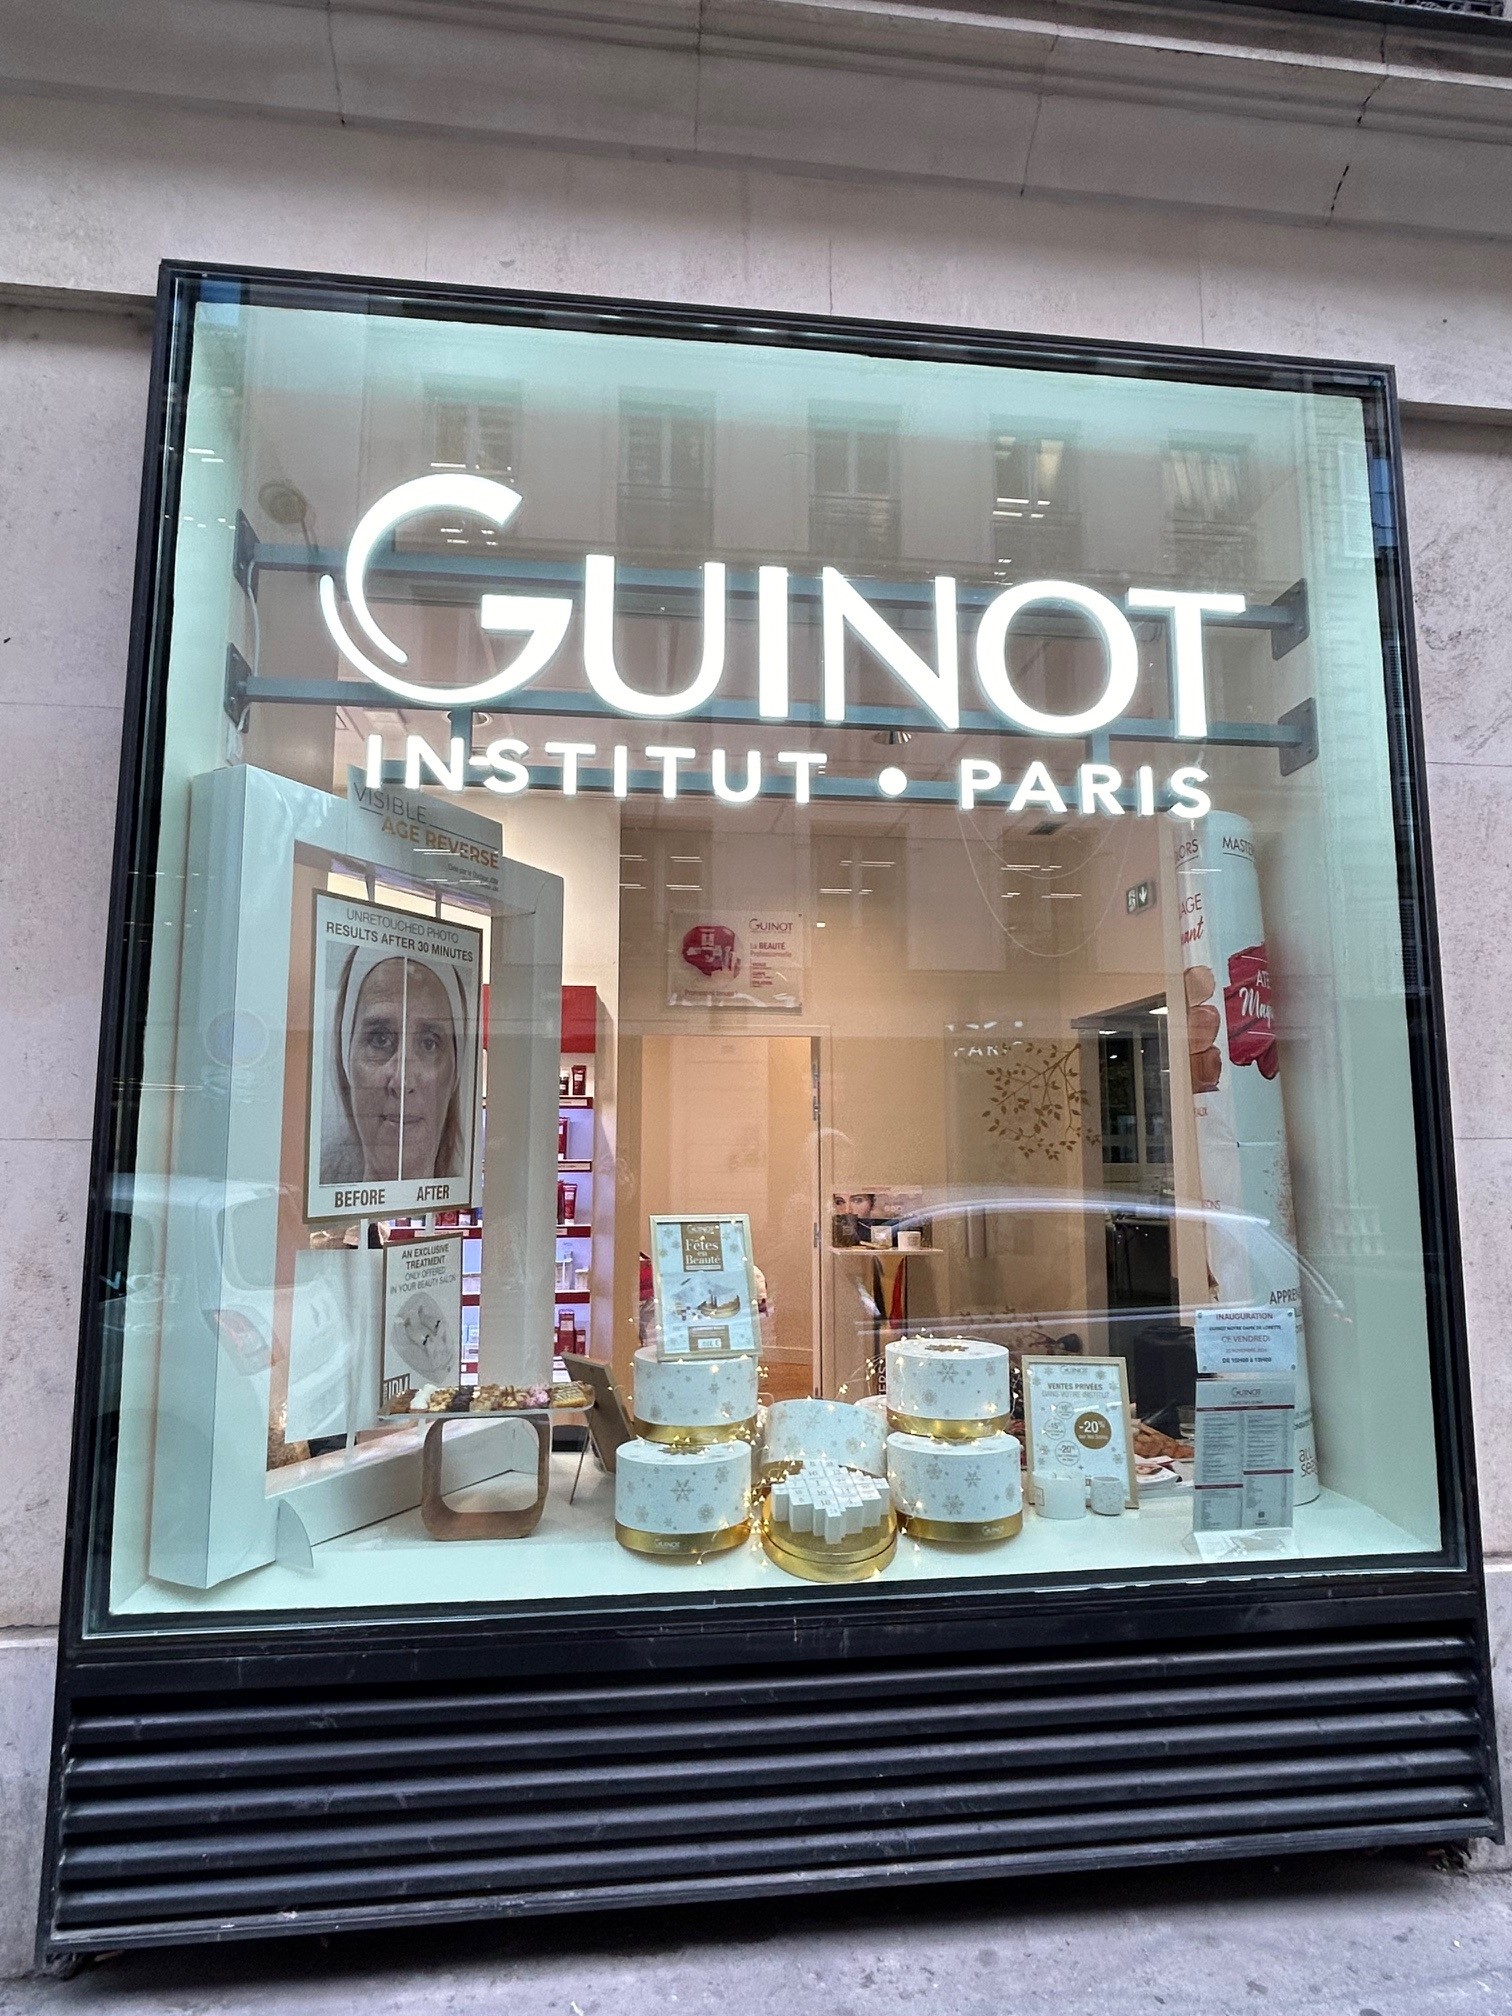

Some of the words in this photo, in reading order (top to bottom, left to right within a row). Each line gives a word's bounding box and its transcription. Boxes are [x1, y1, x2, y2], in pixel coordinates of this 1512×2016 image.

[319, 472, 1246, 739] GUINOT
[364, 733, 828, 805] INSTITUT
[958, 757, 1213, 820] PARIS
[353, 781, 428, 826] VISIBLE
[381, 815, 421, 845] AGE
[425, 830, 500, 870] REVERSE
[346, 907, 425, 937] UNRETOUCHED
[427, 926, 460, 944] PHOTO
[749, 918, 794, 932] GUINOT
[326, 920, 378, 944] RESULTS
[381, 933, 416, 952] AFTER
[417, 940, 430, 954] 30
[431, 943, 474, 963] MINUTES
[759, 942, 786, 951] BEAUTÉ
[334, 1188, 386, 1208] BEFORE
[416, 1184, 450, 1202] AFTER
[402, 1249, 413, 1260] AN
[414, 1242, 450, 1257] EXCLUSIVE
[685, 1239, 719, 1252] Fêtes
[406, 1255, 446, 1270] TREATMENT
[685, 1255, 721, 1264] Beauté
[405, 1271, 421, 1282] ONLY
[422, 1266, 446, 1279] OFFERED
[398, 1281, 417, 1293] YOUR
[417, 1277, 439, 1289] BEAUTY
[439, 1273, 456, 1285] SALON
[1216, 1312, 1274, 1320] INAUGURATION
[1233, 1335, 1271, 1343] VENDREDI
[1075, 1382, 1103, 1391] PRIVÉES
